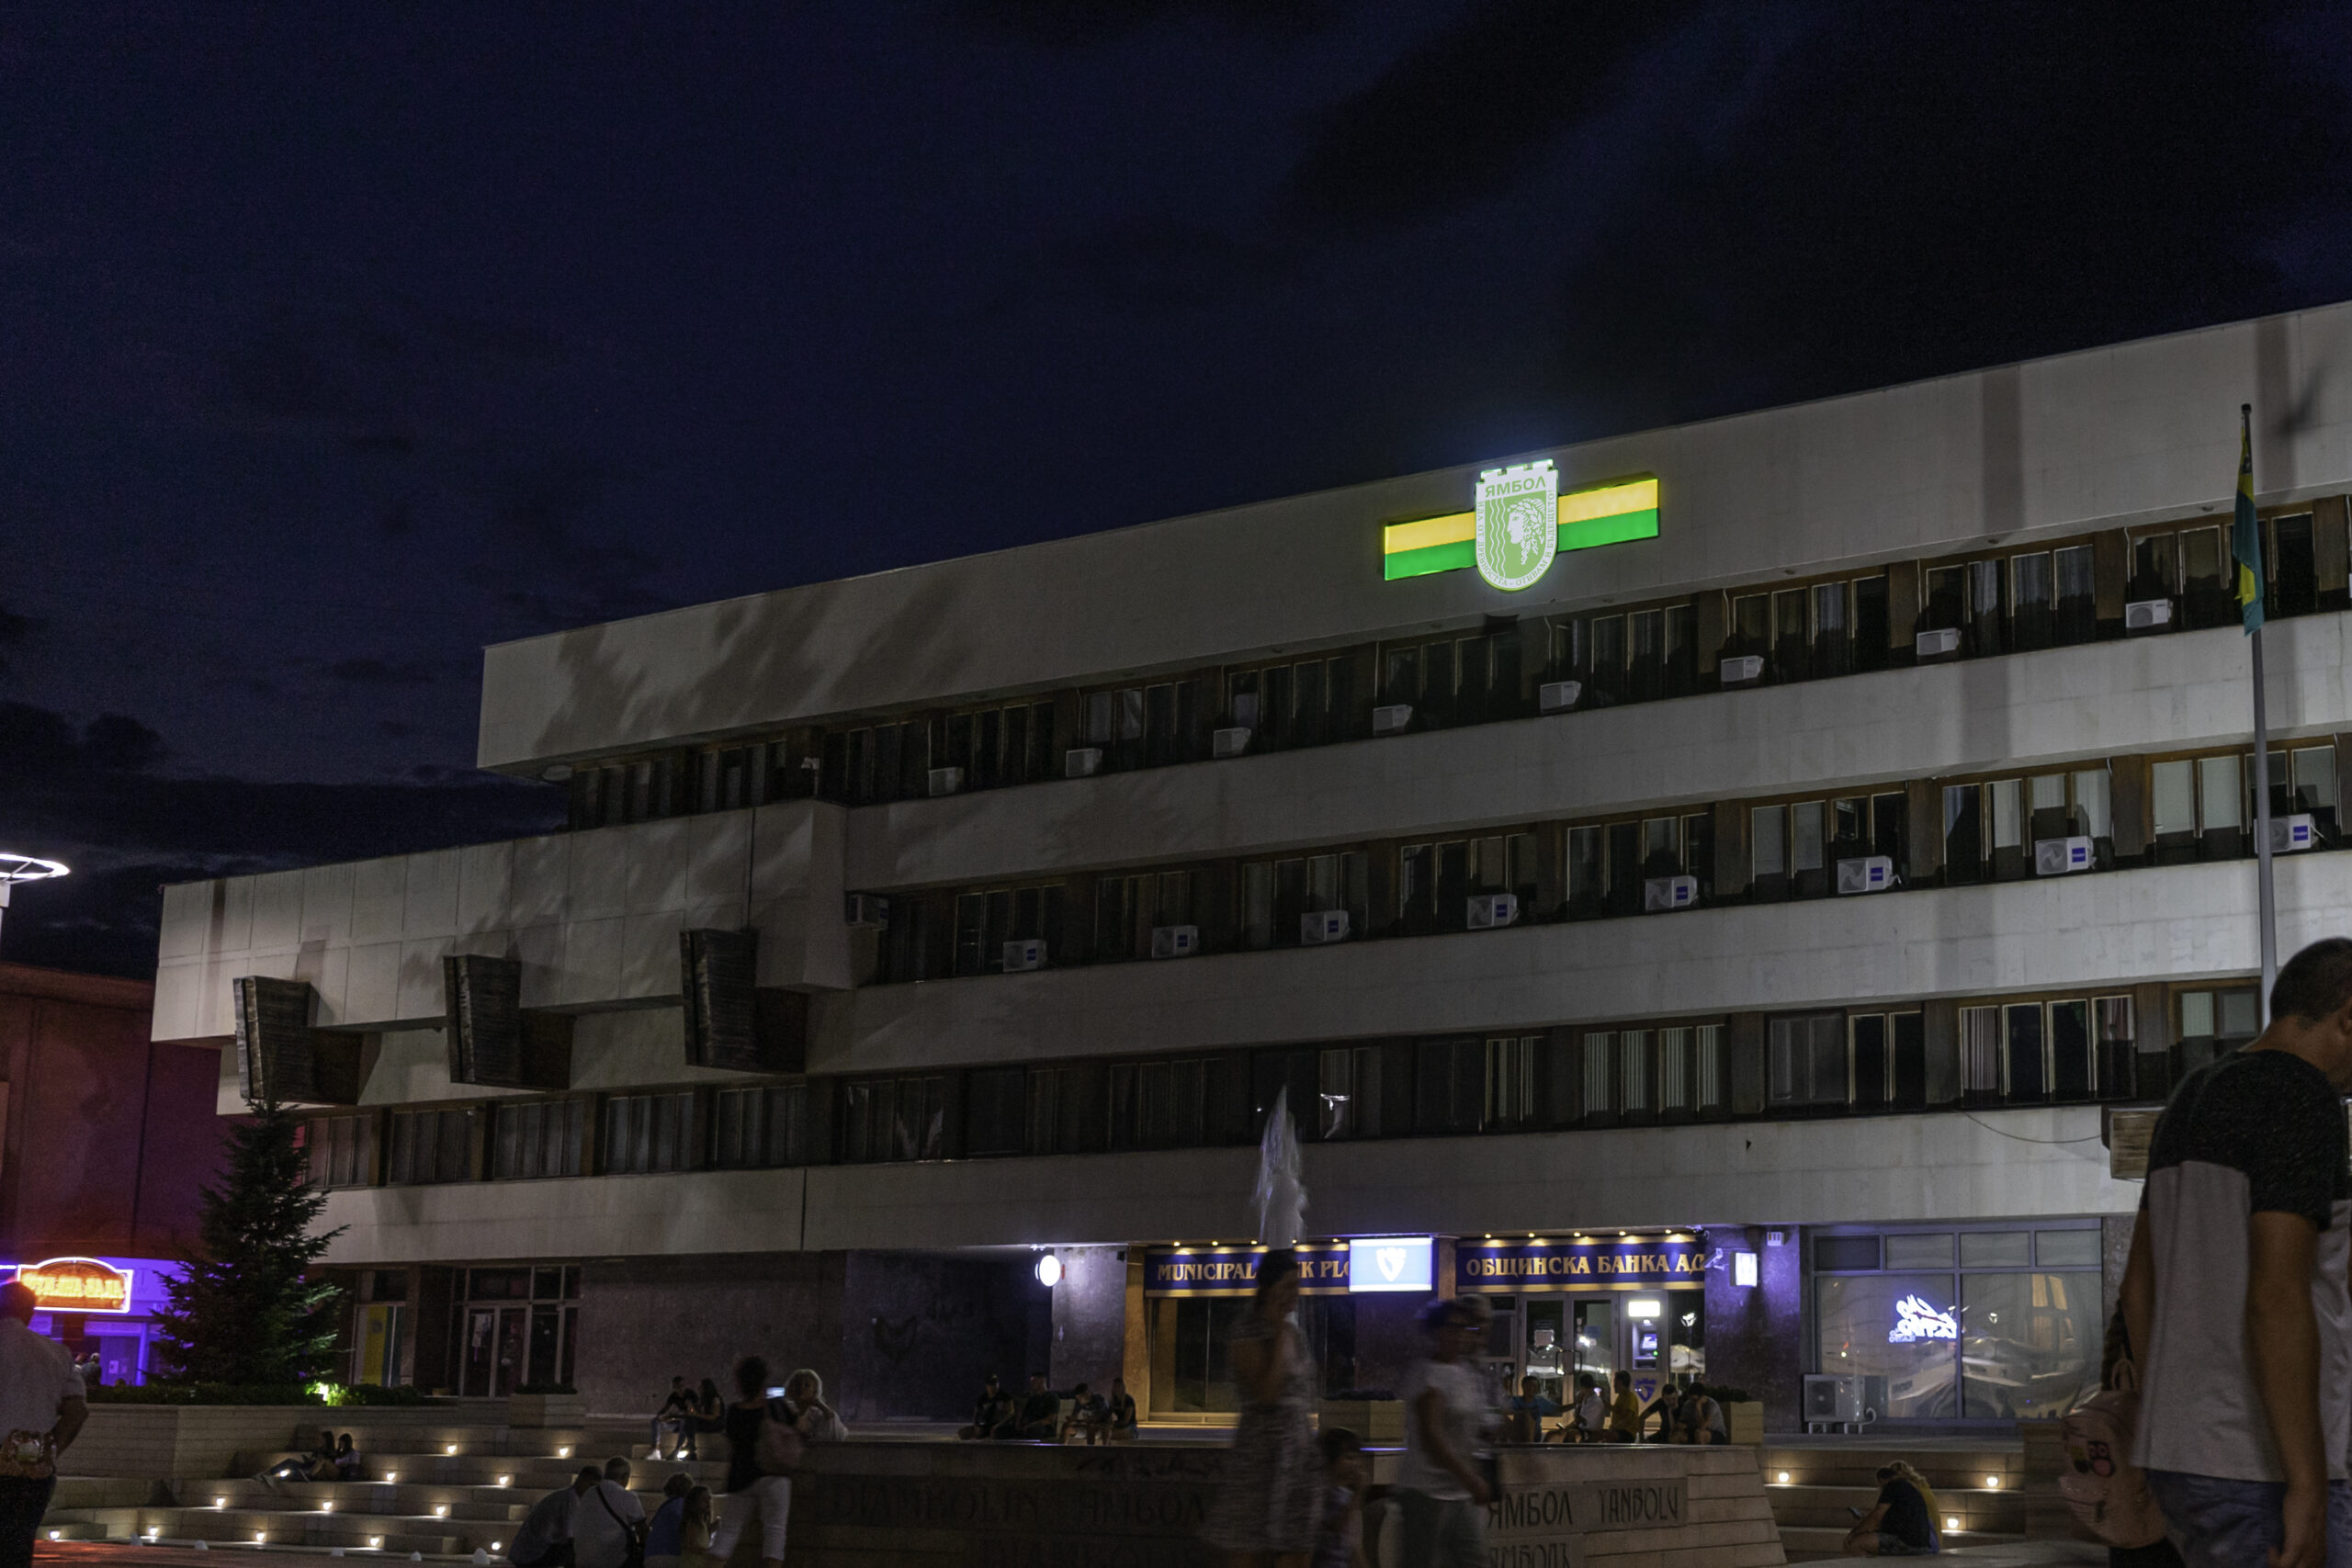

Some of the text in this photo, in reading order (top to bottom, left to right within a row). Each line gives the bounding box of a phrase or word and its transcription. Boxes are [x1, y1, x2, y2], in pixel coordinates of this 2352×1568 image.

[1485, 475, 1546, 498] ЯМБОЛ
[1158, 1262, 1257, 1281] MUNICIPAL
[1466, 1256, 1591, 1278] ОБЩИНСКА
[1598, 1255, 1670, 1274] БАНКА
[1487, 1490, 1574, 1529] ЯМБОЛ
